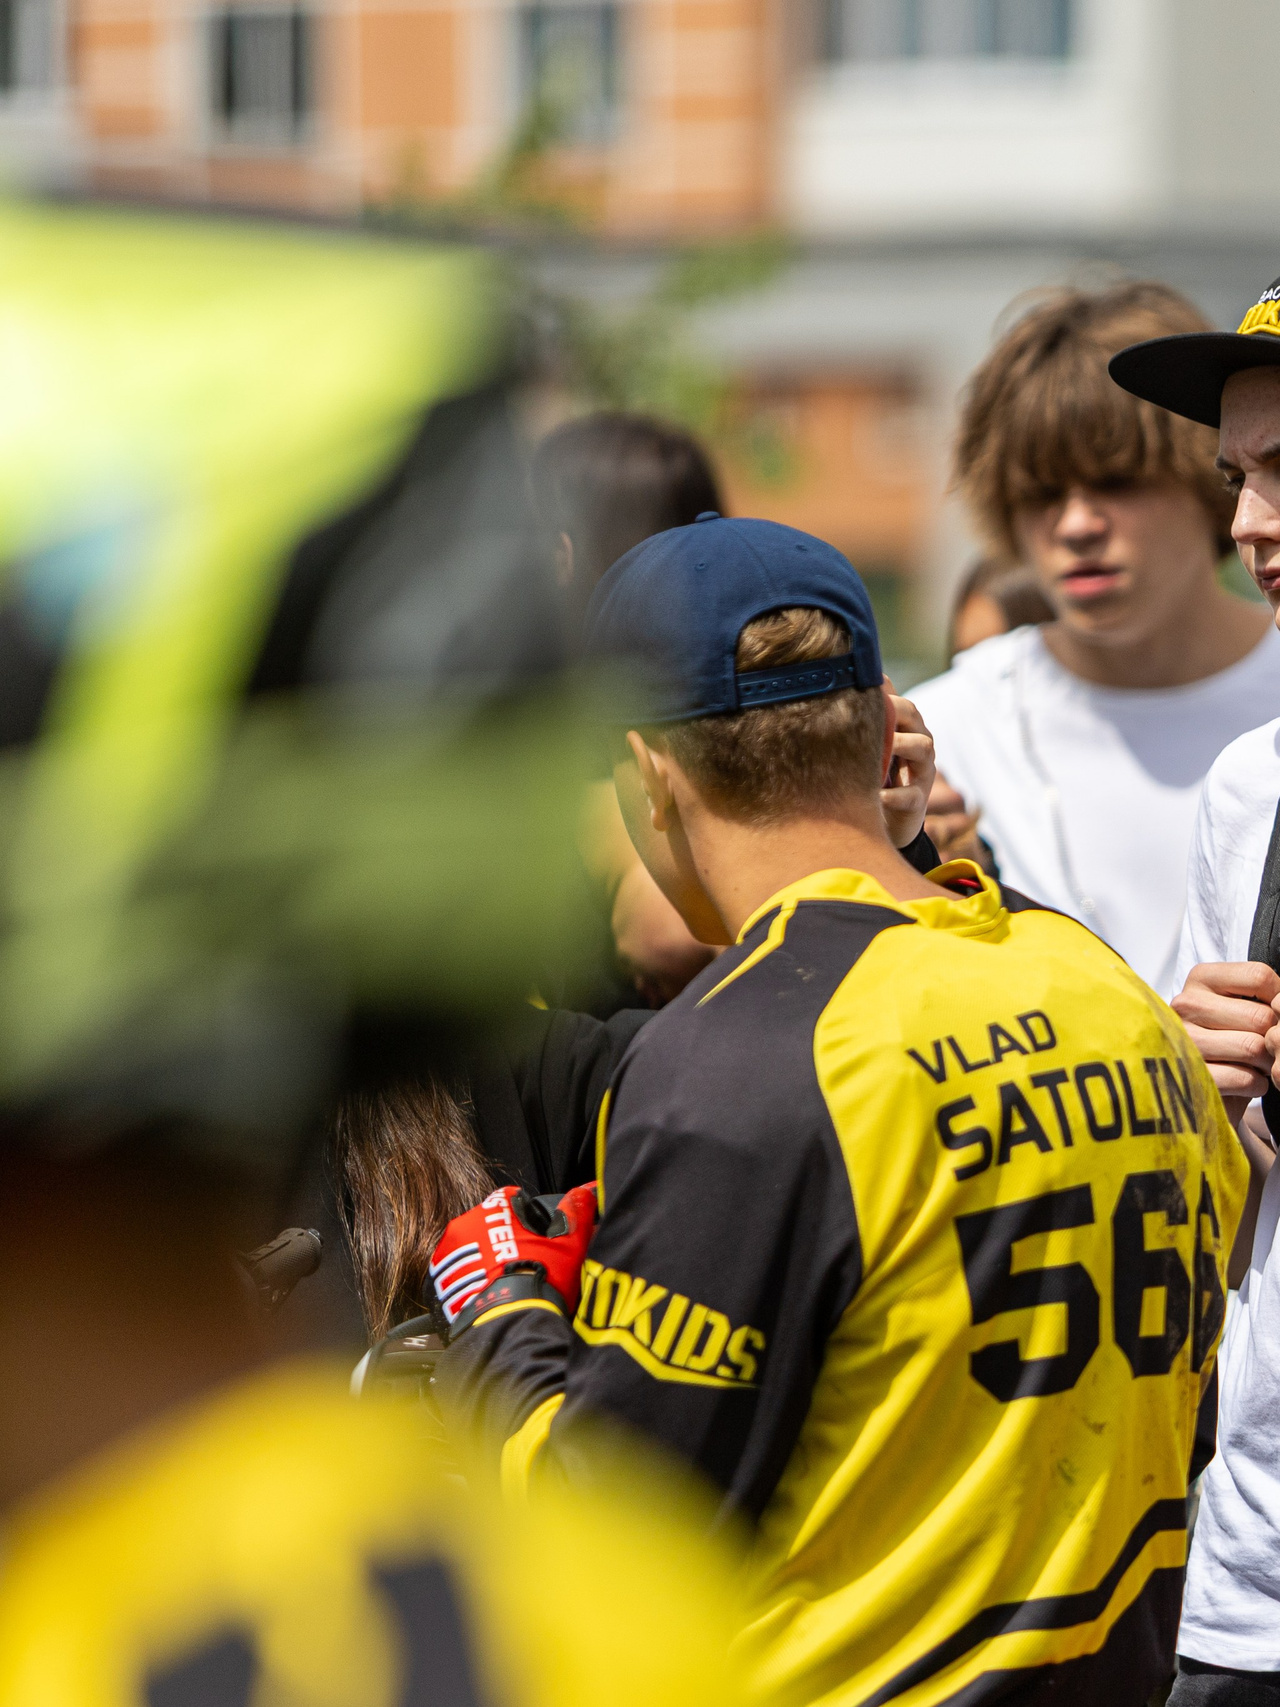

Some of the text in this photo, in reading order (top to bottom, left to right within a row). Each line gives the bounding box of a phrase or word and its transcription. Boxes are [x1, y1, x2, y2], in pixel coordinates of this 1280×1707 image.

[906, 1009, 1057, 1085] VLAD
[935, 1056, 1200, 1182] SATOLIN
[481, 1188, 520, 1263] STER
